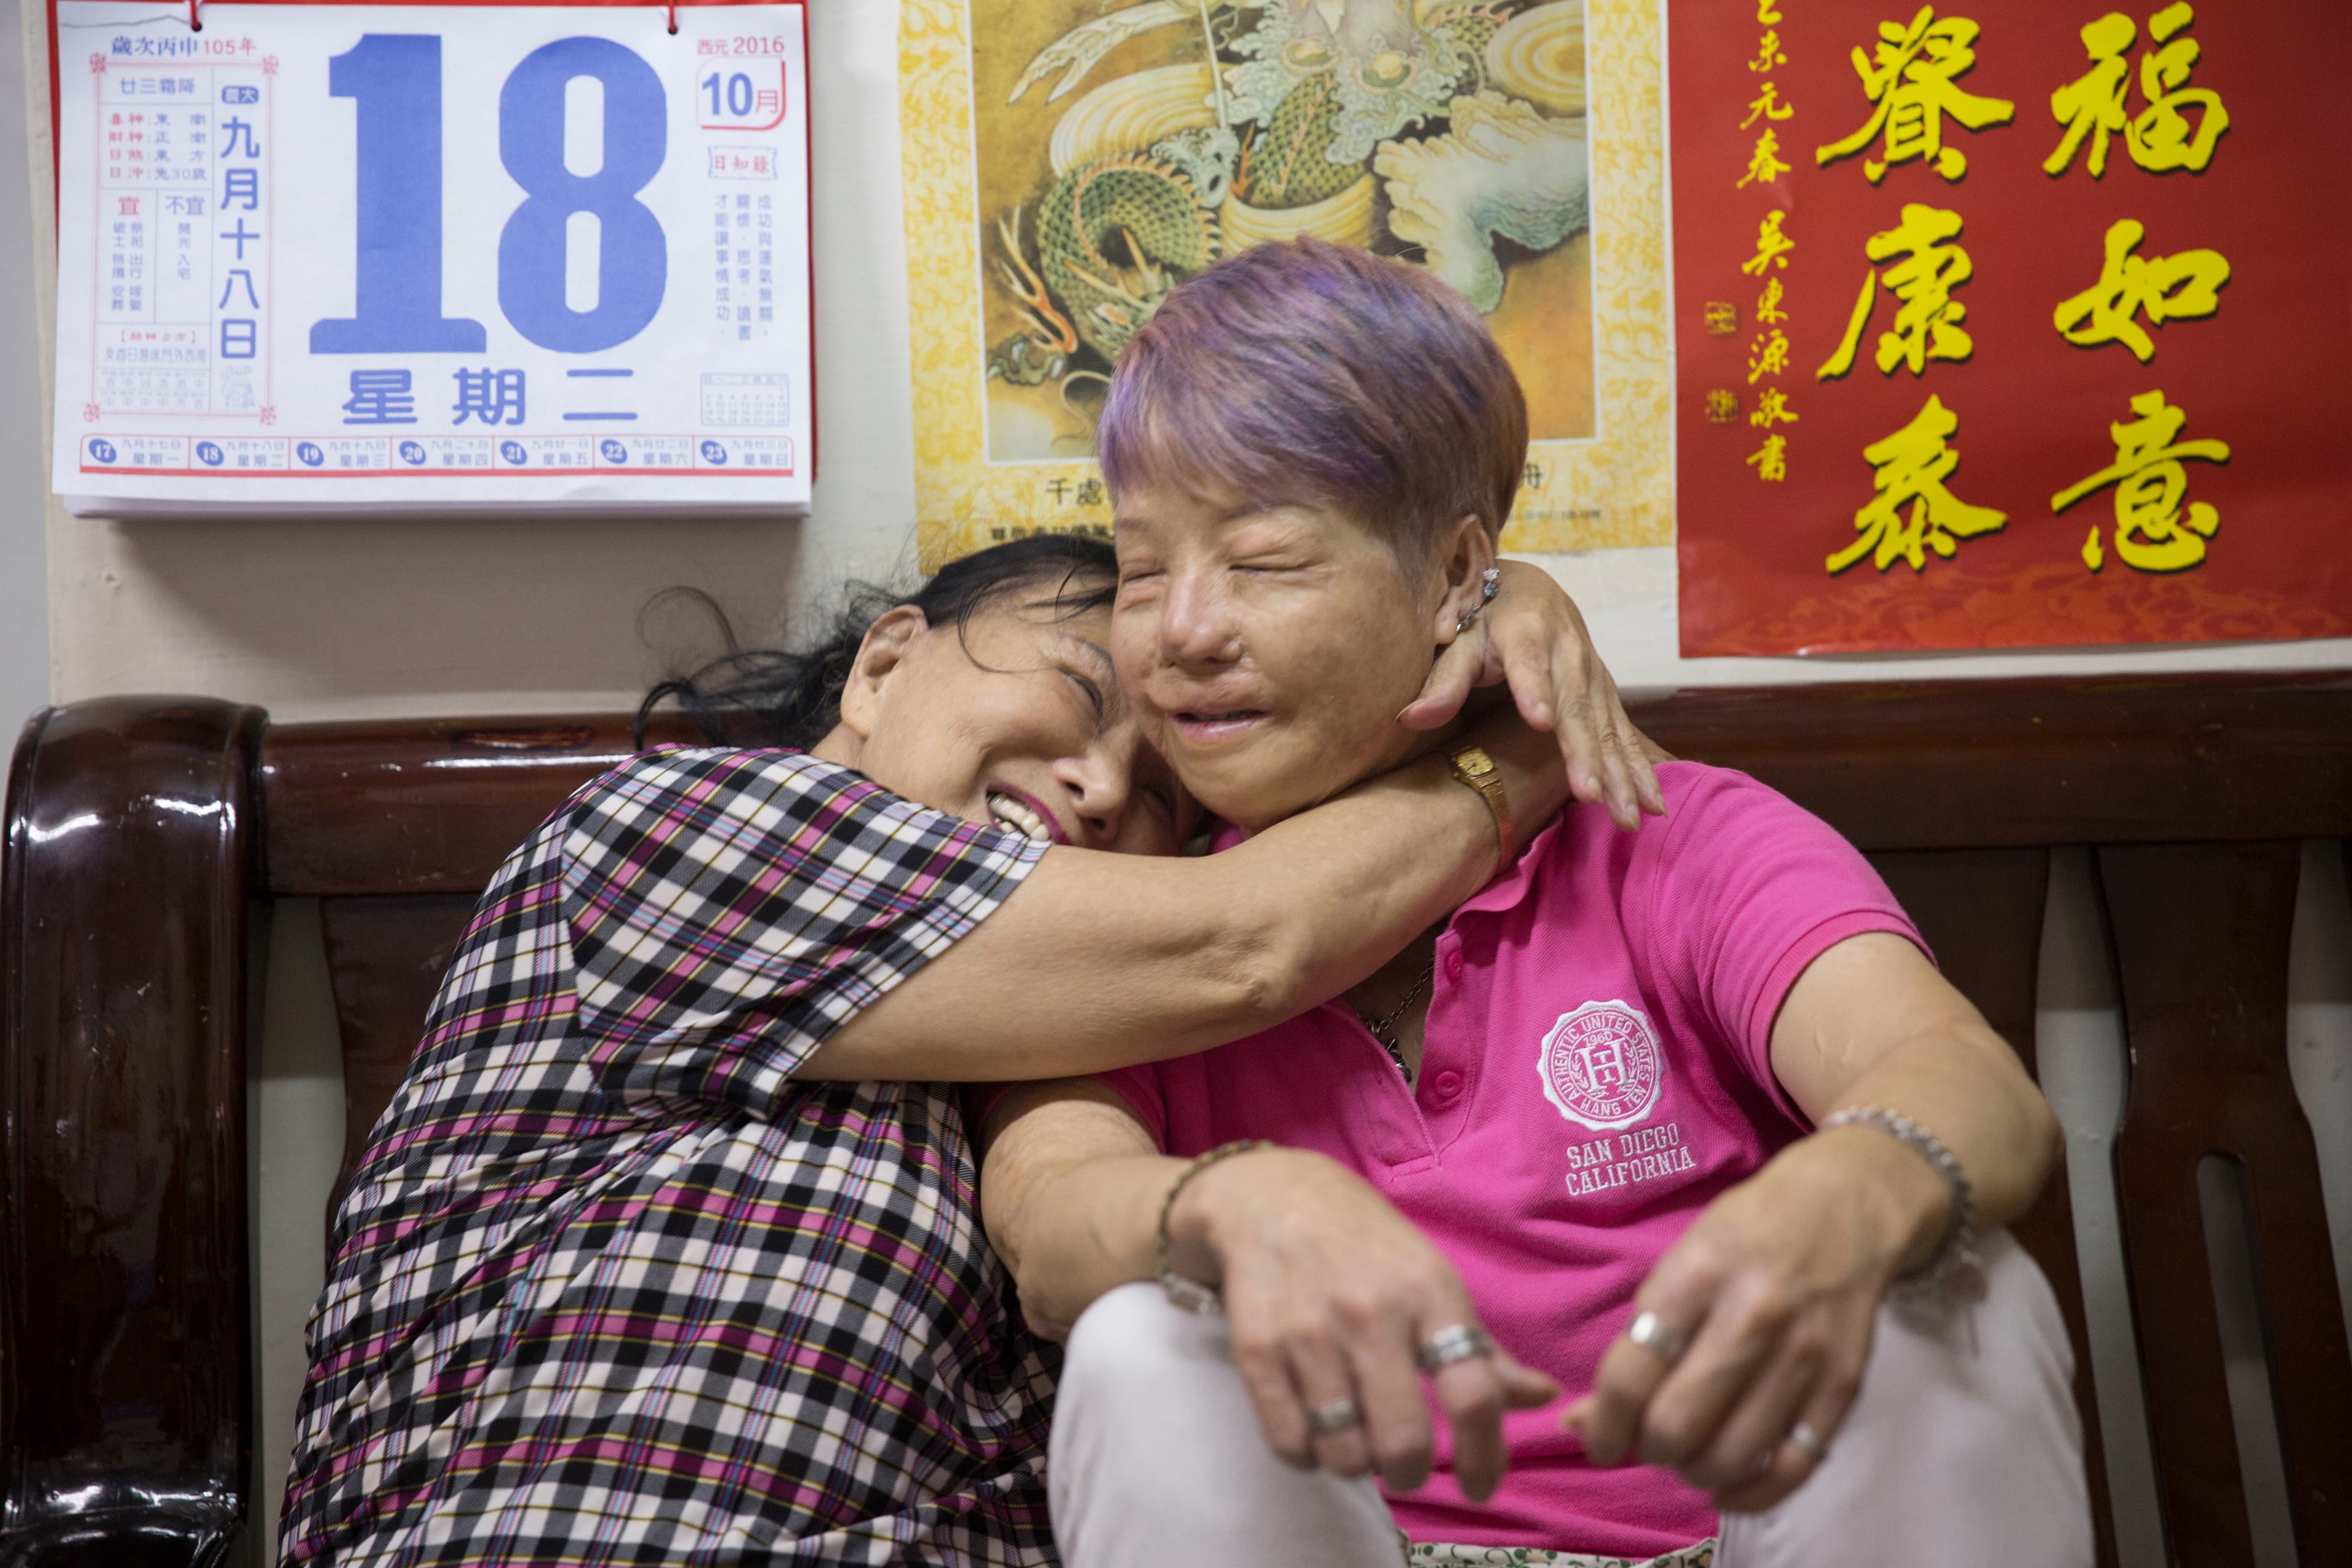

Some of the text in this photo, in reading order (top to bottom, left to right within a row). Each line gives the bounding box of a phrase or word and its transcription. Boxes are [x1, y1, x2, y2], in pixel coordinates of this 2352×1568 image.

[698, 36, 785, 56] 西元 2016
[702, 72, 778, 116] 10月
[309, 34, 667, 354] 18
[119, 197, 140, 215] 宜
[167, 196, 205, 216] 不宜
[219, 116, 260, 359] 九月十八日
[2043, 1, 2230, 571] 福如意
[342, 368, 638, 426] 星期二
[133, 453, 178, 465] 星期一
[238, 454, 282, 467] 星期二
[340, 454, 383, 467] 星期三
[443, 453, 488, 466] 星期四
[543, 453, 587, 466] 星期五
[644, 453, 687, 465] 星期六
[744, 454, 788, 466] 星期日
[1583, 1031, 1613, 1047] 1960
[1555, 1015, 1651, 1100] AUTHENTIC UNITED STATES
[1580, 1084, 1648, 1116] HANG TEN
[1567, 1123, 1681, 1169] SAN DIEGO
[1566, 1146, 1696, 1196] CALIFORNIA
